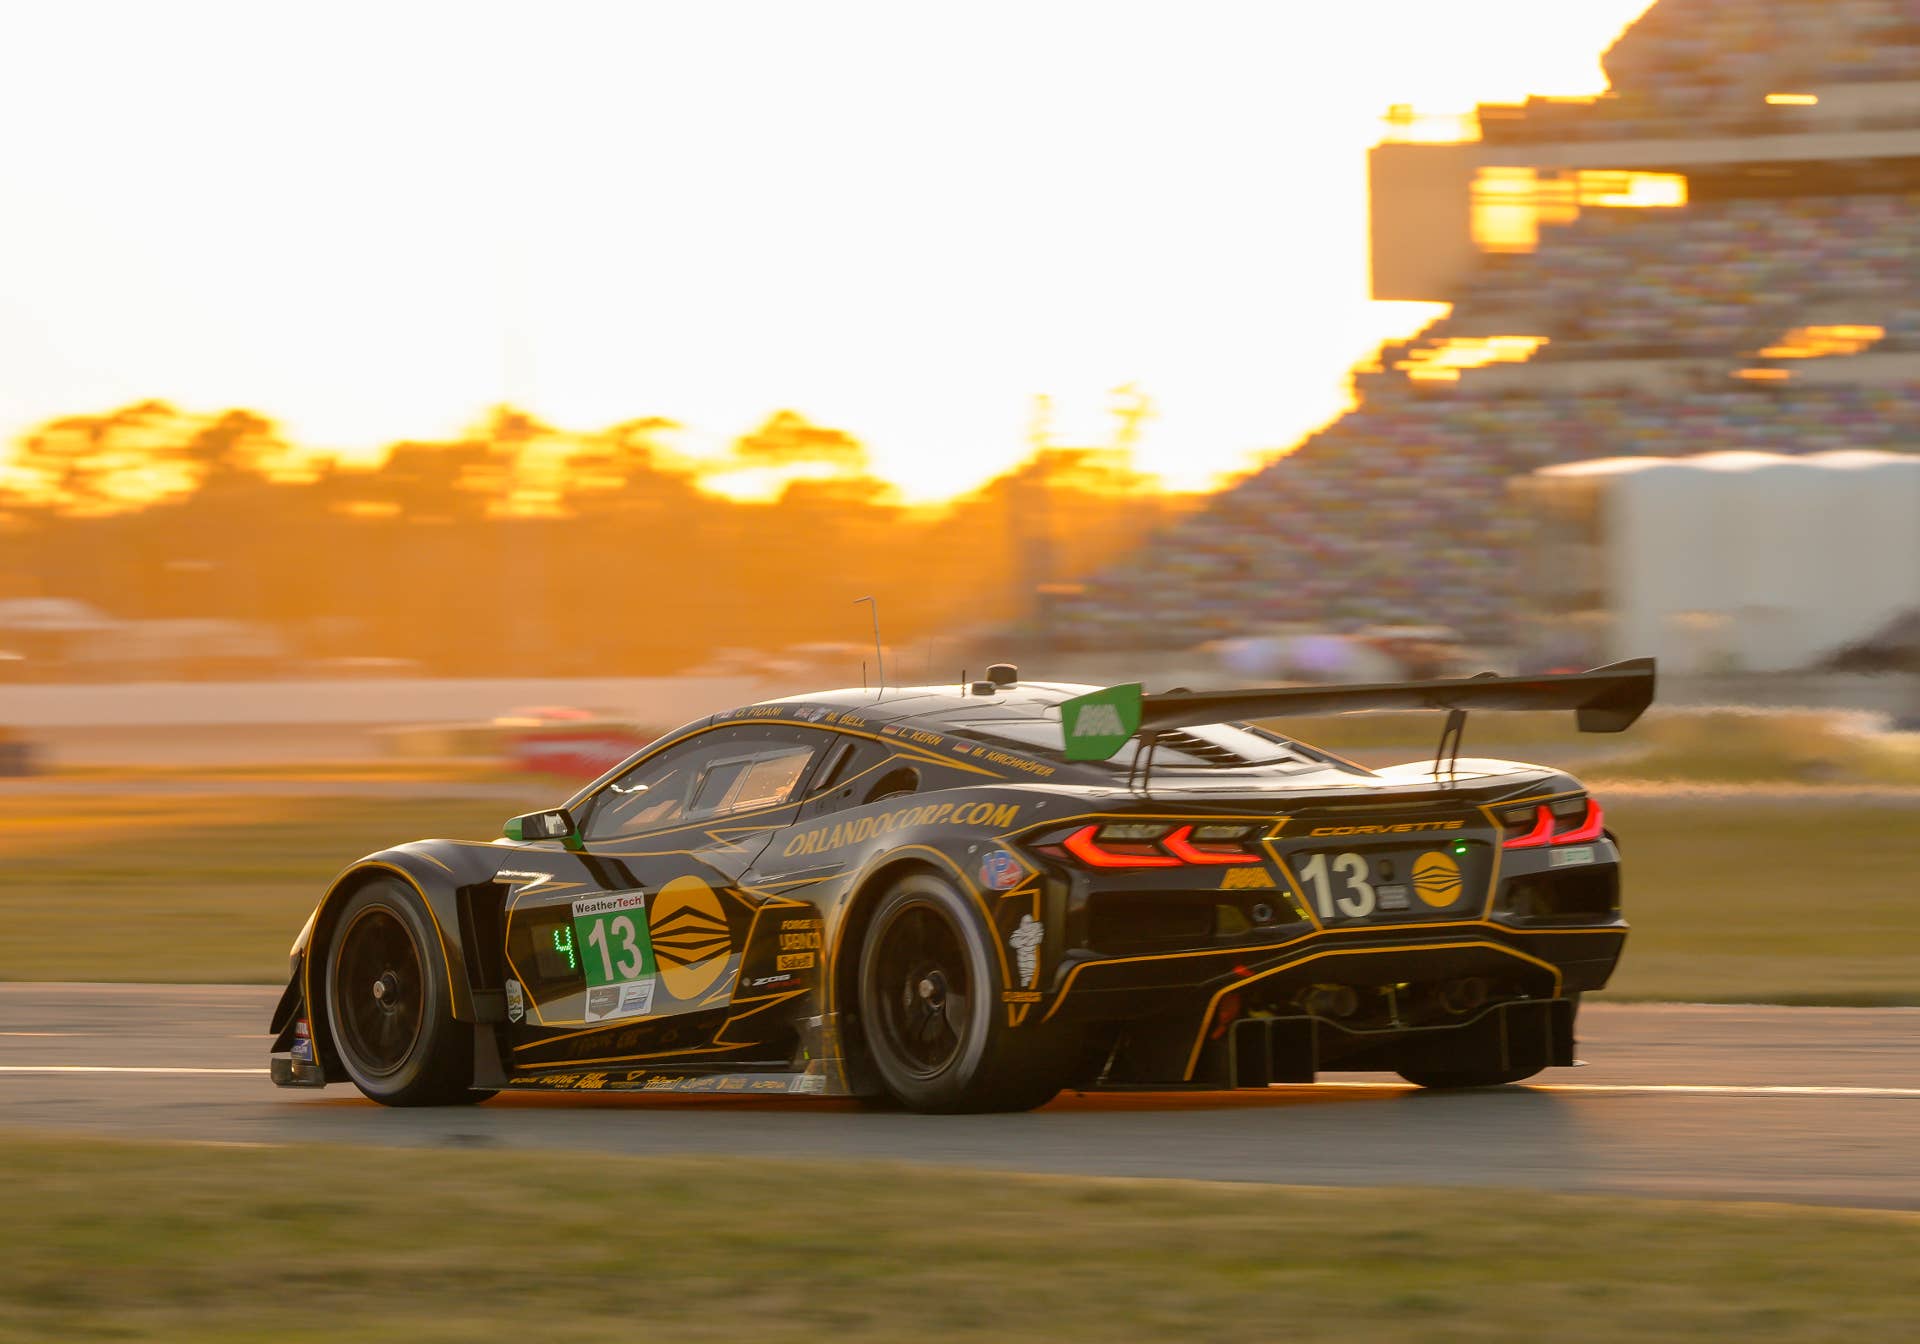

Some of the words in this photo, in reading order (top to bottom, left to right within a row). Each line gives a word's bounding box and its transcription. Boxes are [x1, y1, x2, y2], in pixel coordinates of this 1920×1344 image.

[748, 706, 784, 717] FIDANI
[838, 714, 866, 728] BELL
[910, 729, 945, 746] KERN
[783, 802, 1021, 858] ORLANDOCORP.COM
[1309, 820, 1465, 838] CORVETTE
[1299, 851, 1377, 919] 13
[575, 895, 642, 914] WeatherTech
[553, 926, 575, 968] 4
[588, 915, 643, 981] 13
